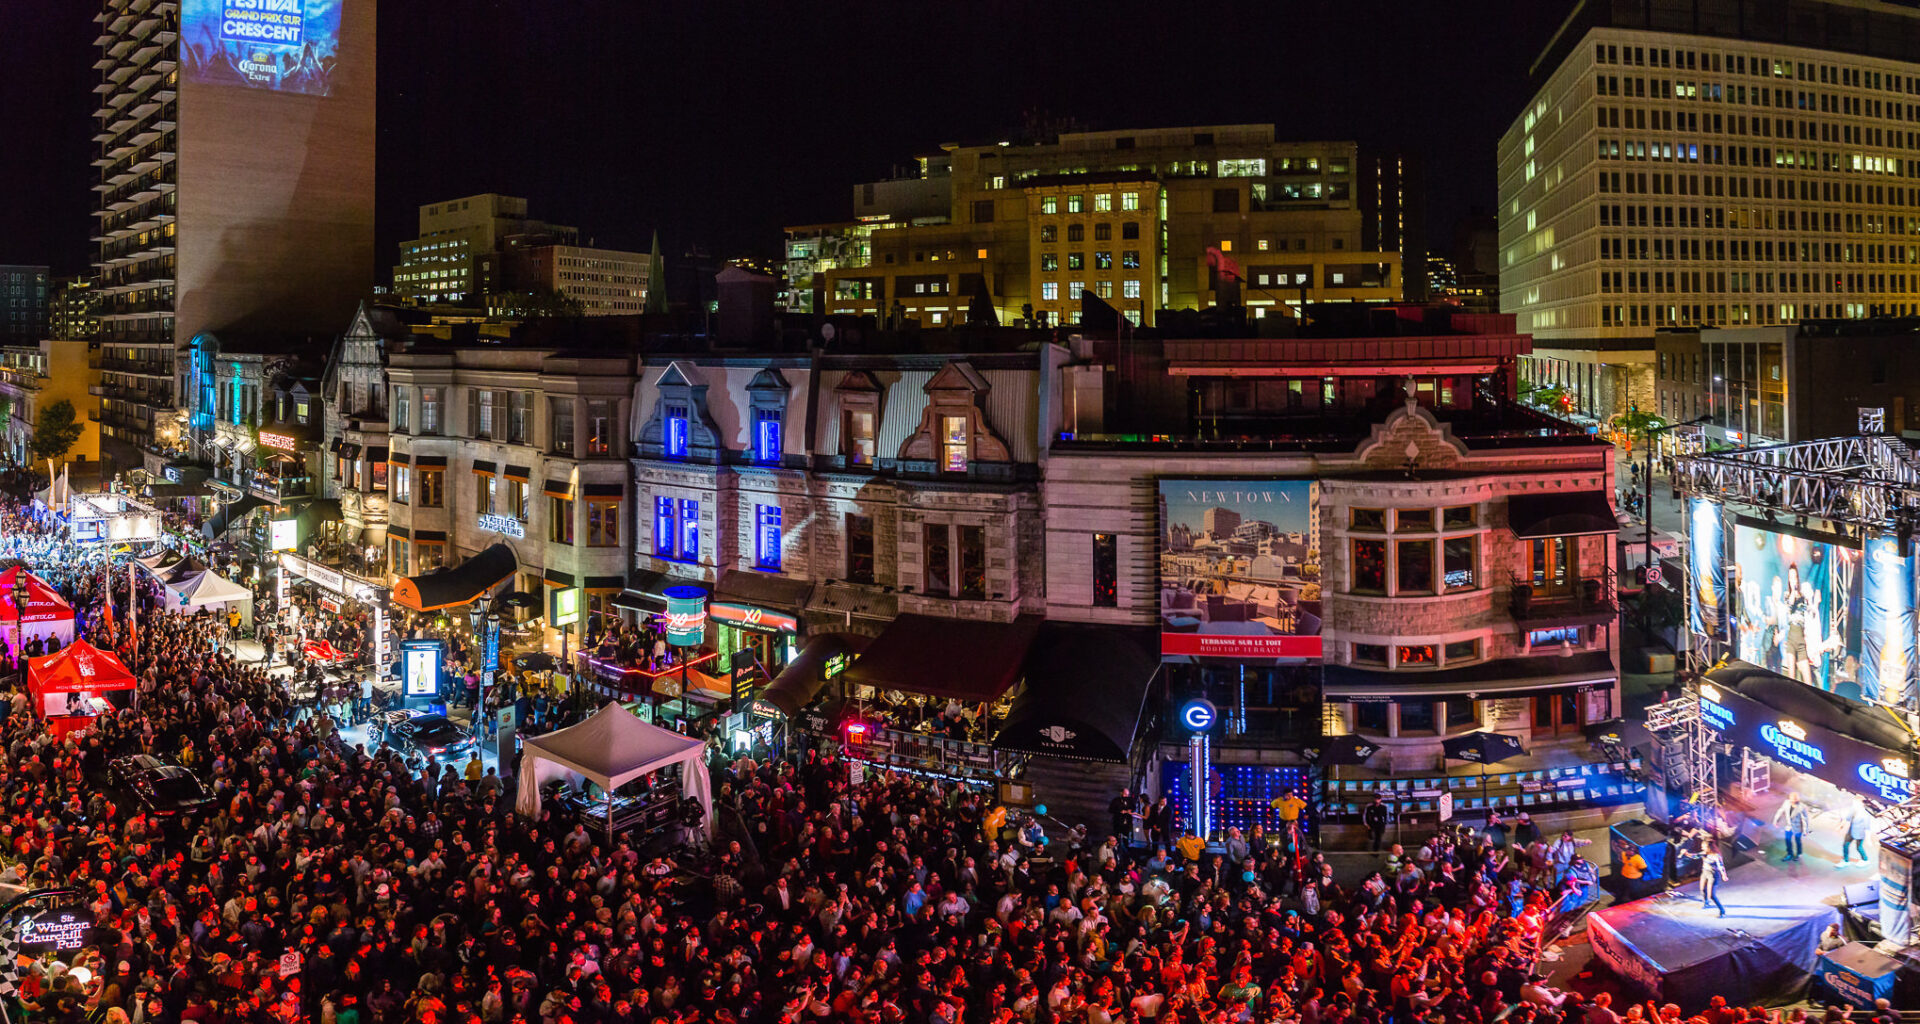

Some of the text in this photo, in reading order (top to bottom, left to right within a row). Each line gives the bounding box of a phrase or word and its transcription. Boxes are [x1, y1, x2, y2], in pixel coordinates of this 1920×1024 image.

[225, 9, 301, 25] GRAND PRIX SUR
[223, 20, 301, 41] CRESCENT
[238, 59, 278, 74] Corona
[249, 71, 270, 81] Extra
[1187, 490, 1291, 503] NEWTOWN
[670, 612, 688, 627] XO
[743, 609, 762, 624] XO
[1200, 638, 1236, 646] TERRASSE
[1200, 645, 1281, 654] ROOFTOP TERRACE
[1700, 697, 1736, 725] rona
[1759, 724, 1826, 765] Corona
[1777, 745, 1813, 769] Extra
[1858, 763, 1916, 795] Coro
[61, 914, 76, 923] Sir
[35, 921, 91, 934] Winston
[21, 929, 83, 943] Churchill
[56, 939, 83, 950] Pub
[1824, 972, 1873, 1001] Corona
